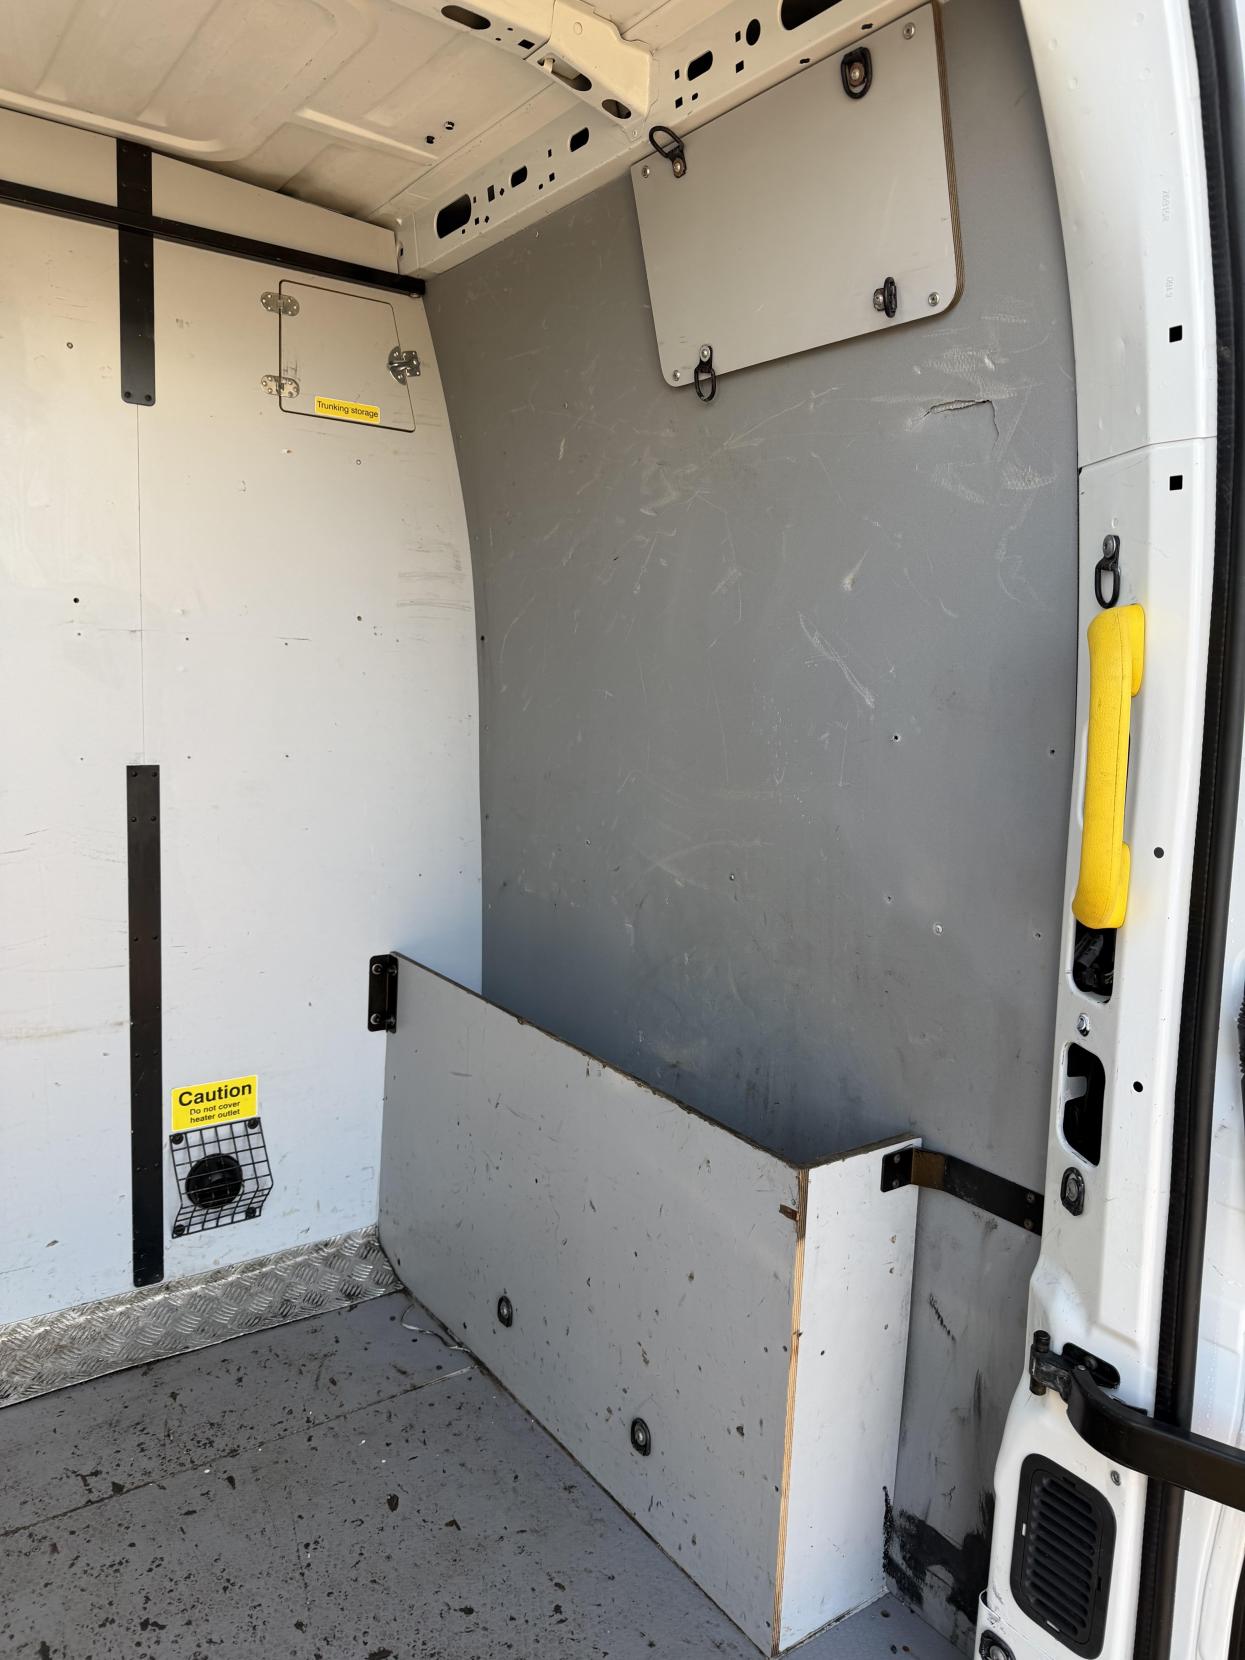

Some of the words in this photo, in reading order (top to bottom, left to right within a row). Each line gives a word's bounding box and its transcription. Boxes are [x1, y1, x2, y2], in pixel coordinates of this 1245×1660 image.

[317, 400, 349, 414] Trunking
[351, 407, 378, 419] storage
[178, 1084, 252, 1106] Caution
[218, 1101, 240, 1110] cover
[190, 1114, 215, 1123] heater
[217, 1109, 240, 1118] outlet
